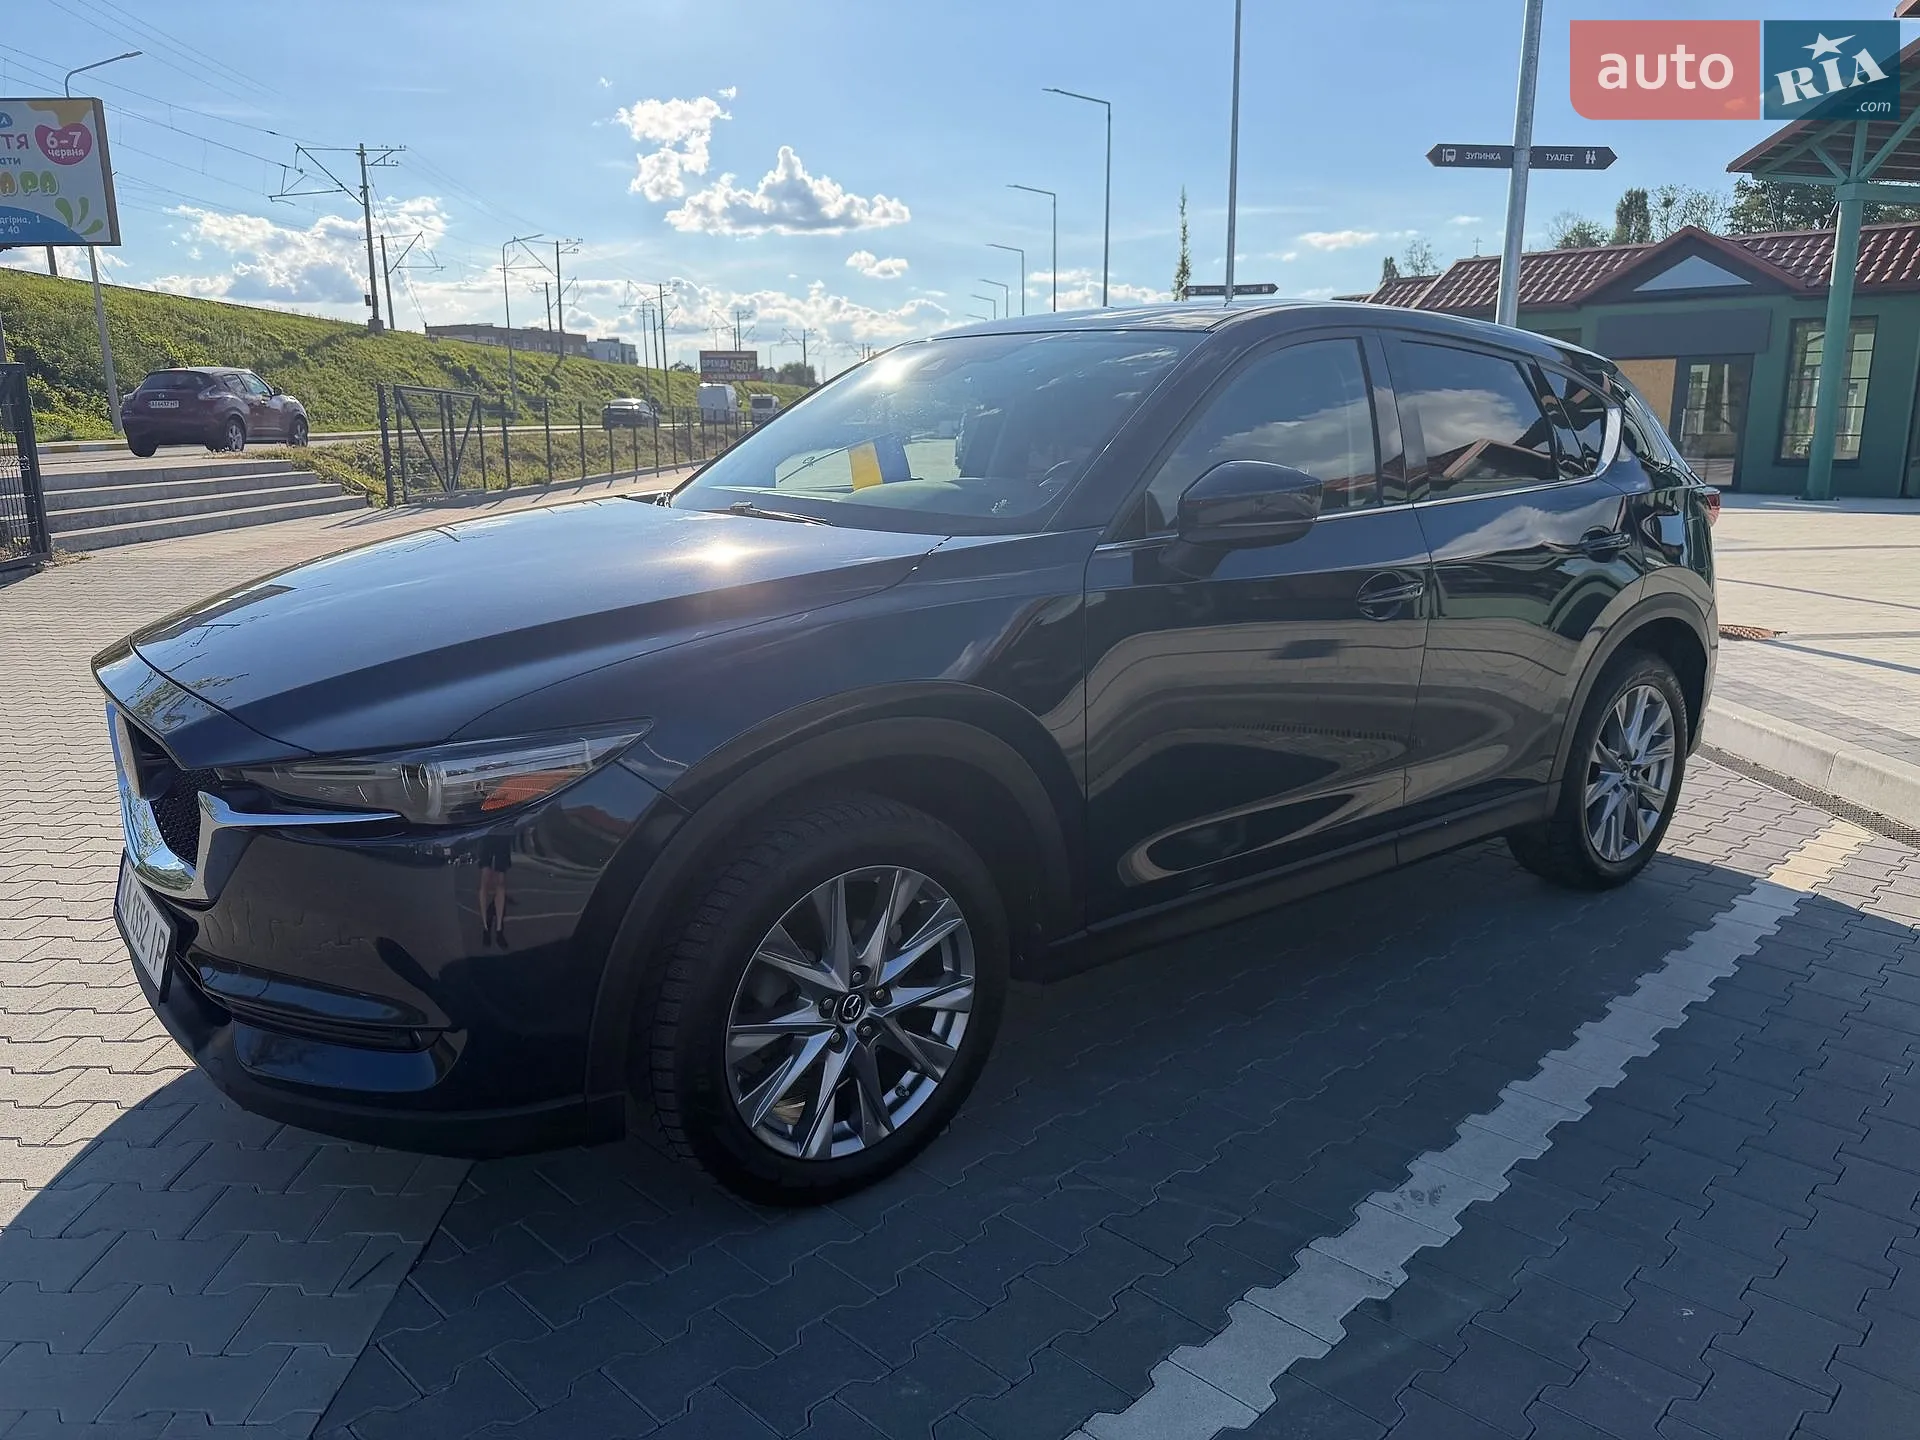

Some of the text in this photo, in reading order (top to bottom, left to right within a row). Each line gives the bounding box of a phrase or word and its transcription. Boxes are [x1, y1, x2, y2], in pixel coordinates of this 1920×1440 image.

[48, 148, 85, 159] червня
[1464, 151, 1502, 161] ЗУПИНКА
[1545, 153, 1575, 162] ТУАЛЕТ
[8, 225, 20, 234] 40
